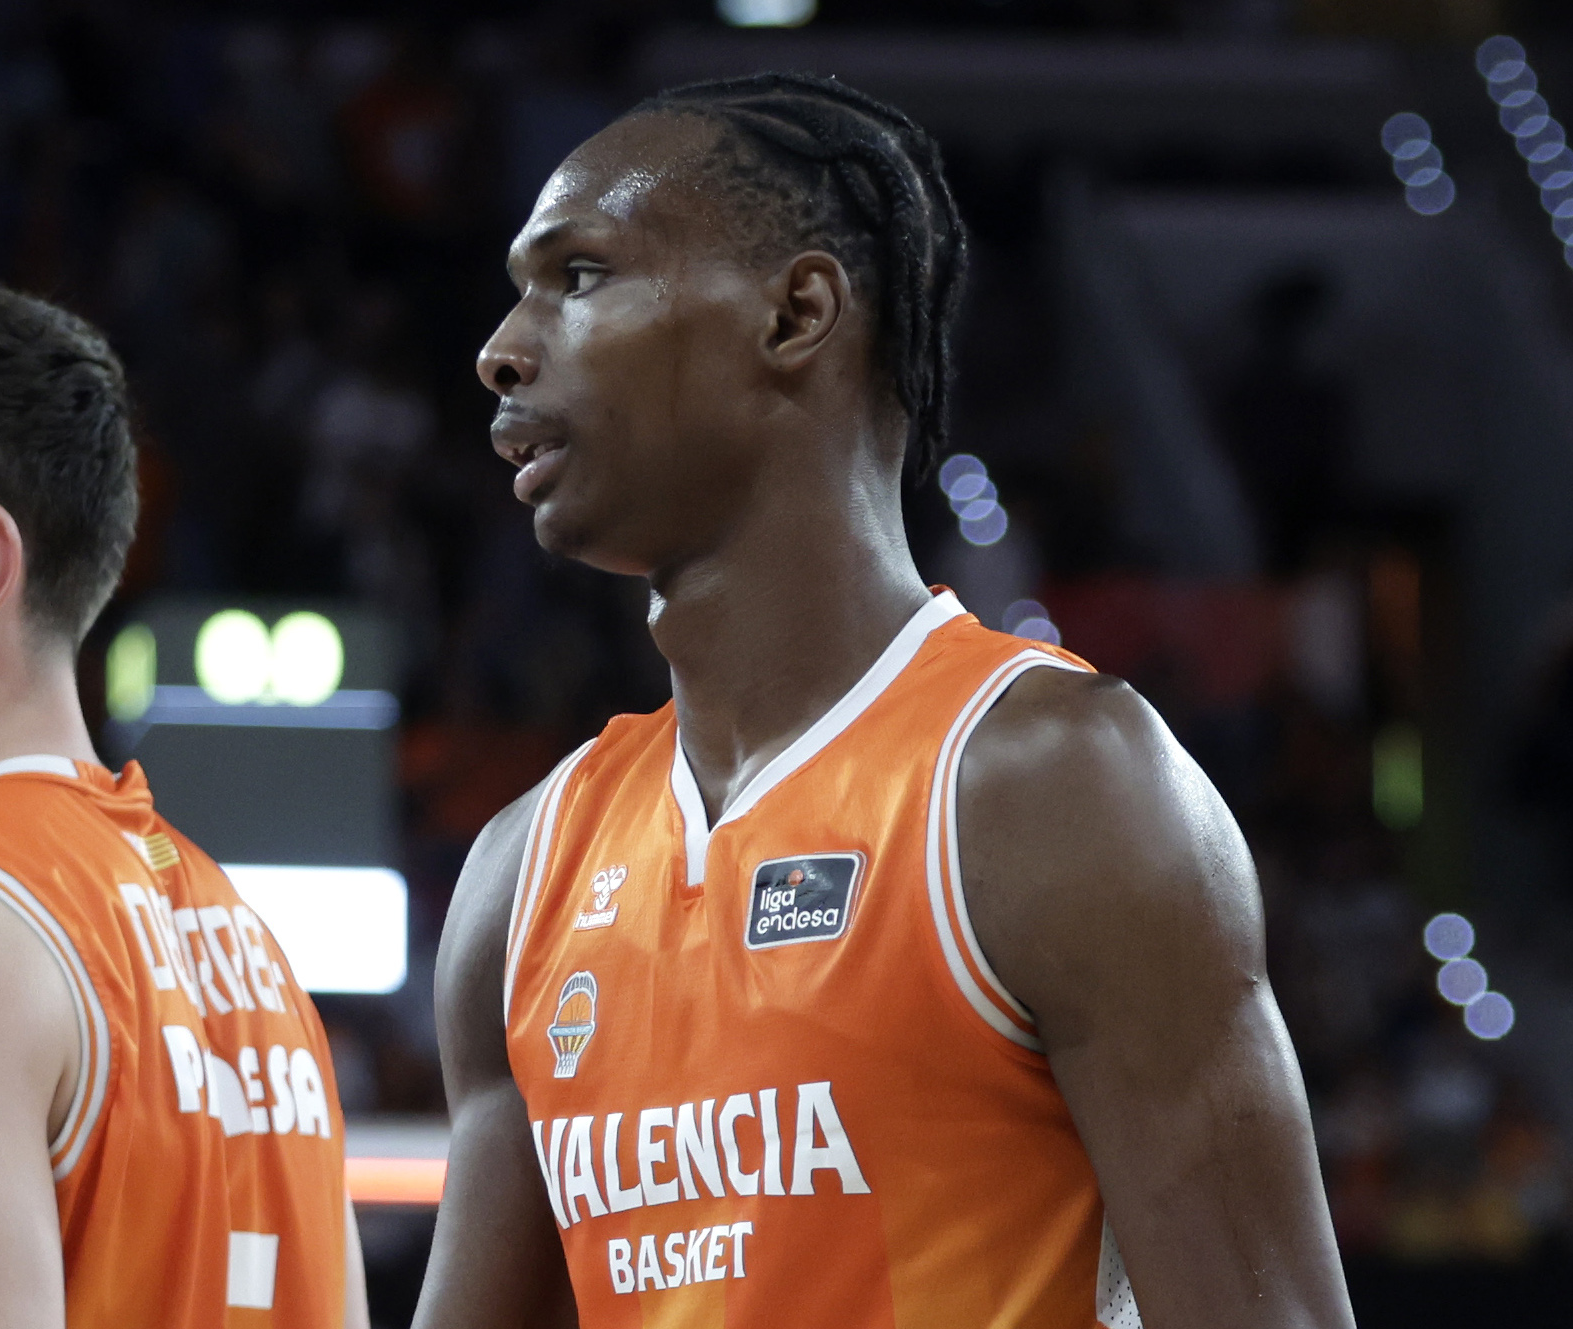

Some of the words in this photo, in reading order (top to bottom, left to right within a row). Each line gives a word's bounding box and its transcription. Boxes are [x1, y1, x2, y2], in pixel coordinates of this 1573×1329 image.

[756, 906, 840, 934] endesa
[760, 887, 796, 913] liga
[532, 1081, 872, 1229] VALENCIA
[608, 1221, 754, 1294] BASKET
